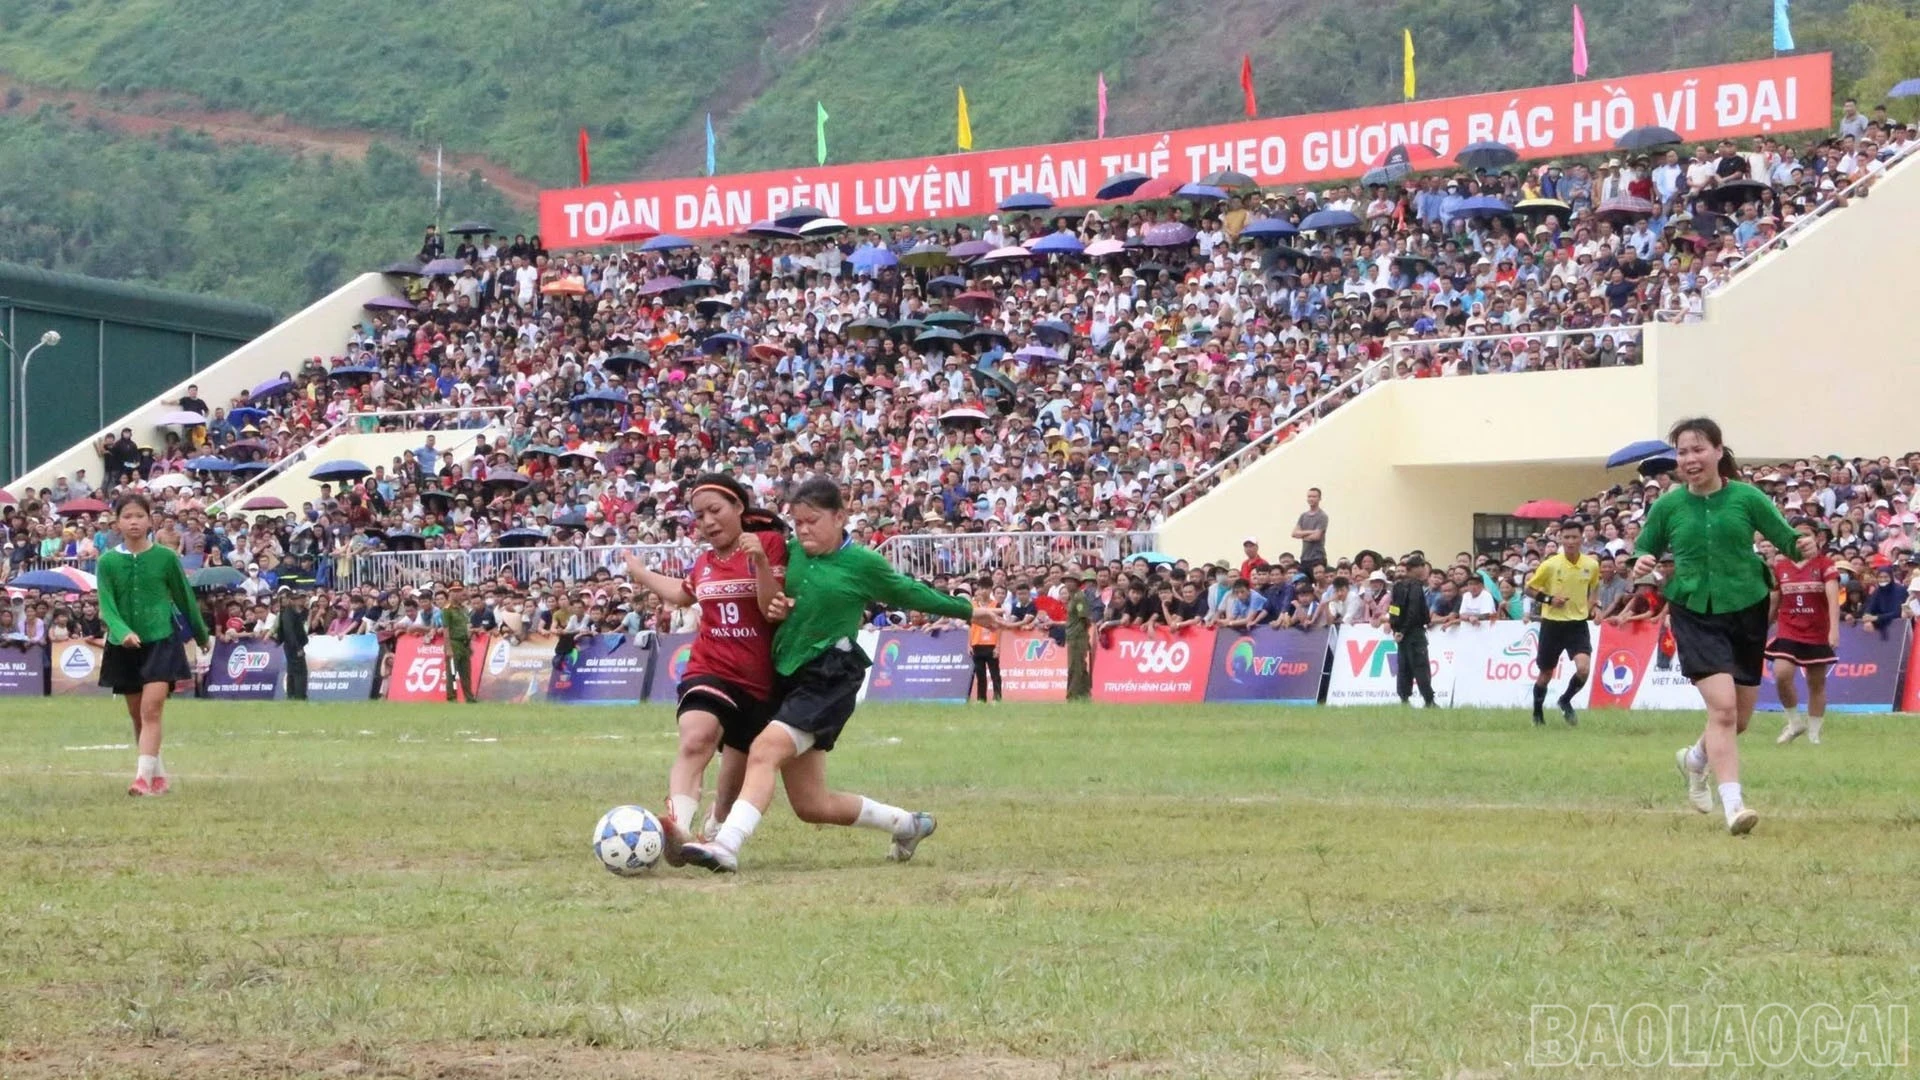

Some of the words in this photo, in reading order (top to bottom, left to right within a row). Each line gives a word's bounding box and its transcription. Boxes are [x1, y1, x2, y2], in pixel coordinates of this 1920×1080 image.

[564, 191, 660, 238] TOÀN
[675, 184, 752, 230] DÂN
[855, 164, 971, 217] LUYỆN
[989, 153, 1087, 203] THÂN
[1101, 134, 1170, 180] THỂ
[1185, 136, 1286, 183] THEO
[1303, 118, 1449, 171] GƯƠNG
[1468, 98, 1554, 150] BÁC
[1573, 85, 1634, 144] HỒ
[1652, 79, 1698, 131] VĨ
[1714, 77, 1797, 131] ĐẠI
[1796, 594, 1803, 606] 9
[717, 602, 740, 625] 19
[405, 657, 443, 692] 5G
[1278, 662, 1309, 676] CUP
[1486, 658, 1522, 680] Lao
[1834, 663, 1878, 677] CUP
